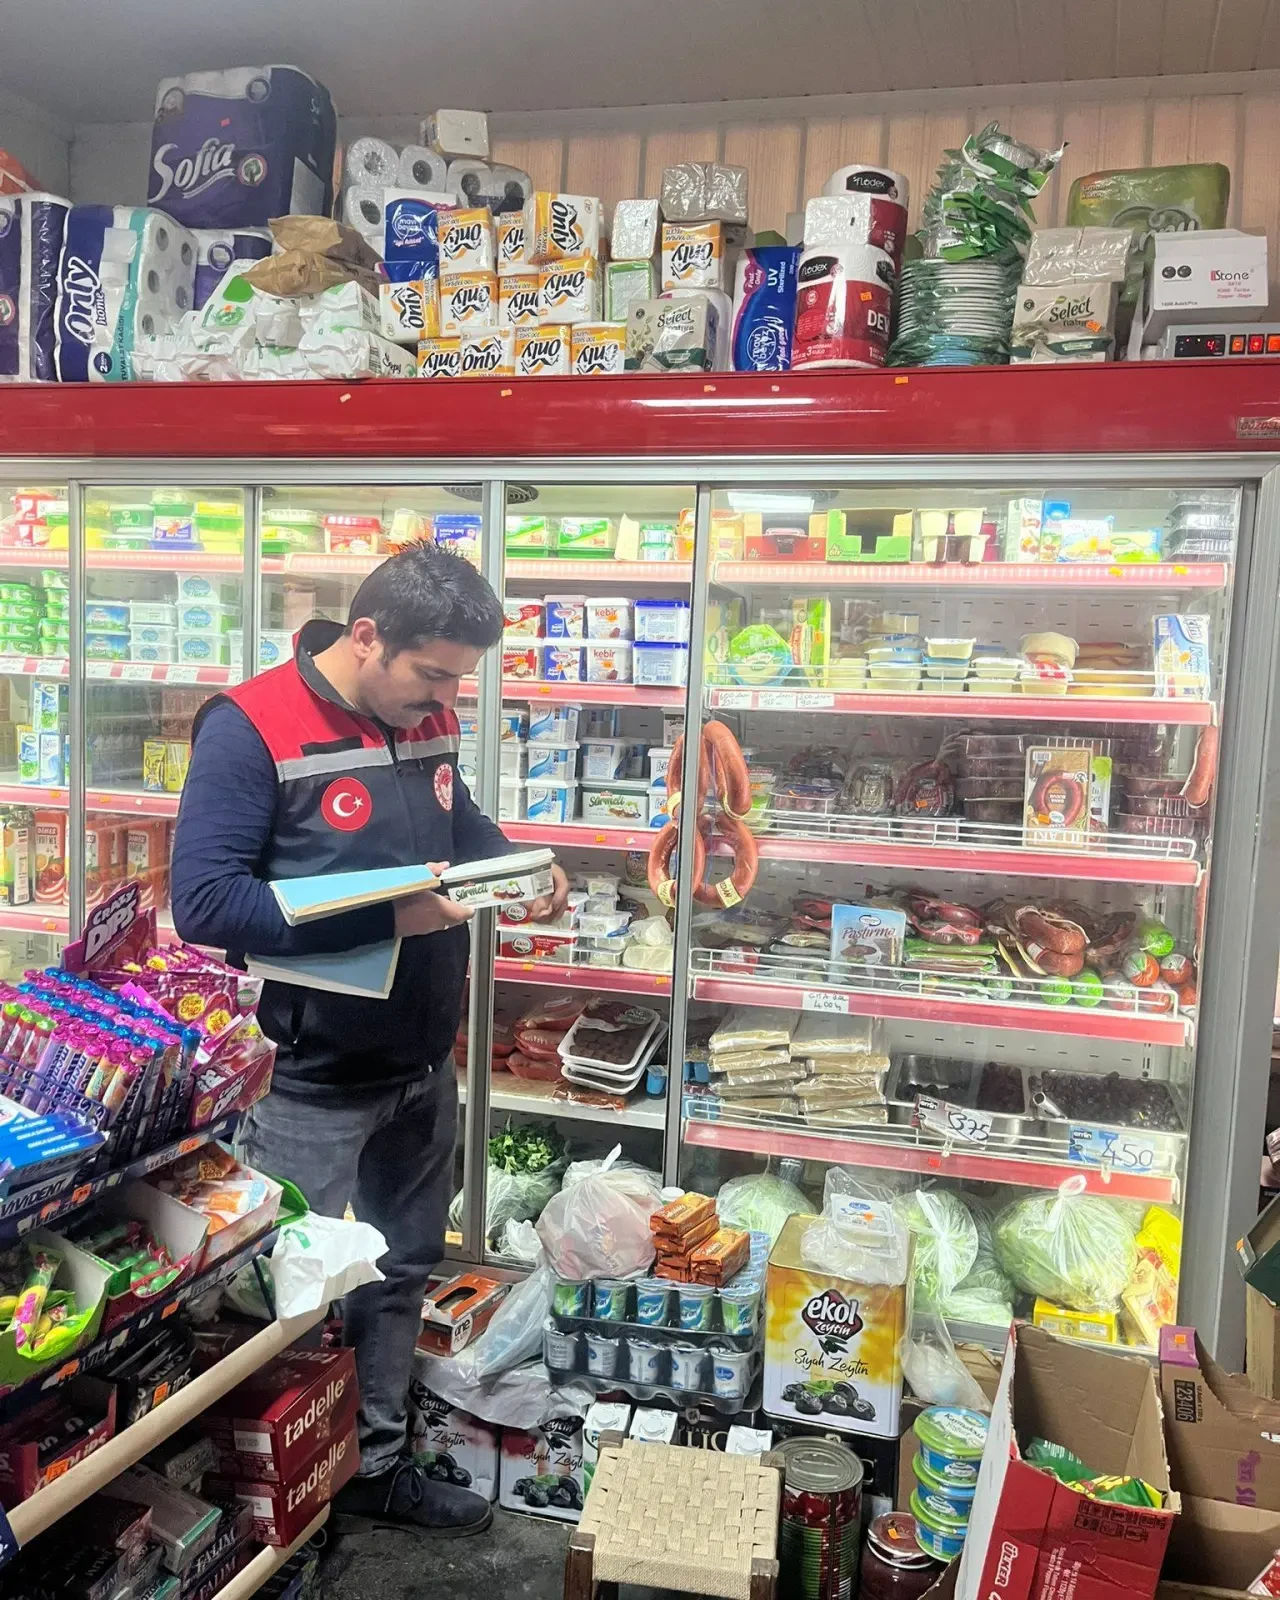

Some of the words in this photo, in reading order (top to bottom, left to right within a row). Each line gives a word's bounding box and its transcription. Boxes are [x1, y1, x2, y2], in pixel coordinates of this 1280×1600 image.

[148, 137, 236, 204] Sofia
[443, 223, 482, 245] Only
[551, 200, 570, 251] Only
[671, 242, 714, 263] Only
[544, 270, 586, 292] Only
[767, 267, 778, 286] UV
[777, 261, 786, 294] Sterilized
[64, 256, 100, 344] Only
[96, 291, 107, 326] home
[404, 287, 425, 328] Only
[451, 285, 491, 306] Only
[1050, 297, 1092, 322] Select
[1063, 319, 1088, 327] natur
[462, 350, 502, 372] Only
[521, 338, 562, 360] Only
[594, 607, 618, 617] kebir
[593, 649, 616, 658] kebir
[93, 888, 136, 925] CRAZY
[84, 899, 137, 965] DIPS
[807, 1296, 859, 1325] ekol
[814, 1321, 851, 1336] Zeytin
[794, 1348, 824, 1370] Siyah
[828, 1357, 869, 1378] Zeytin
[283, 1377, 346, 1449] tadelle
[430, 1429, 467, 1449] Zeytin
[286, 1439, 347, 1514] tadelle
[995, 1541, 1018, 1588] ÜLKER
